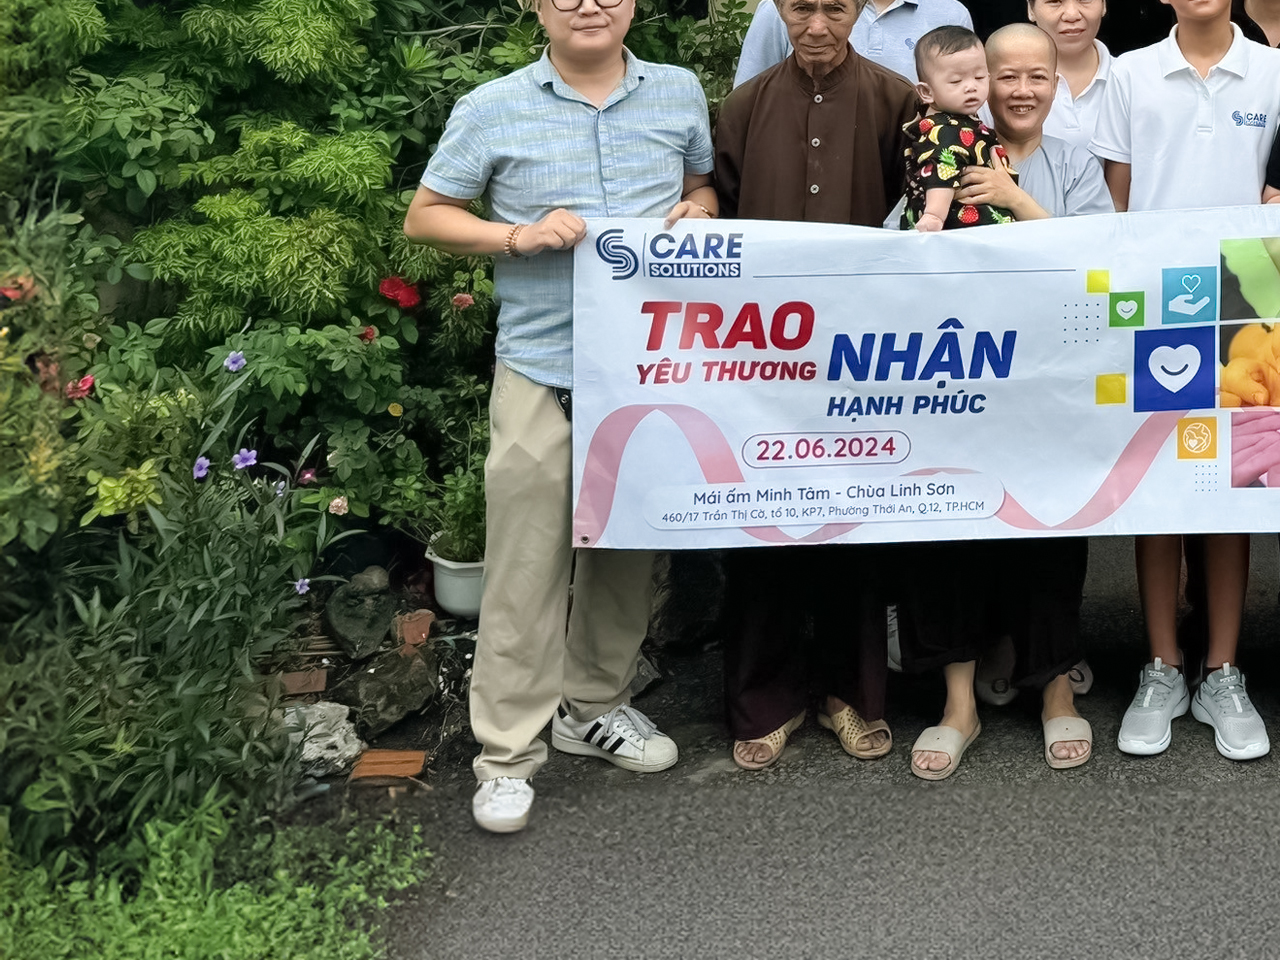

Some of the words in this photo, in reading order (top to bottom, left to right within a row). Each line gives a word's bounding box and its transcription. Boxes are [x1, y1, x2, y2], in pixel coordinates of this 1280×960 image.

[1246, 112, 1267, 123] CARE
[649, 233, 744, 259] CARE
[650, 263, 740, 277] SOLUTIONS
[641, 300, 815, 351] TRAO
[827, 317, 1018, 389] NHẬN
[636, 357, 692, 385] YÊU
[702, 360, 817, 383] THƯƠNG
[826, 395, 904, 422] HẠNH
[912, 390, 987, 414] PHÚC
[756, 436, 896, 461] 22.06.2024
[693, 491, 721, 506] Mái
[726, 487, 751, 503] ấm
[756, 487, 792, 502] Minh
[797, 486, 831, 500] Tâm
[846, 484, 885, 499] Chùa
[890, 483, 921, 497] Linh
[926, 482, 955, 496] Sơn
[662, 511, 699, 524] 460/17
[828, 505, 869, 517] Phường
[945, 501, 984, 512] TP.HCM
